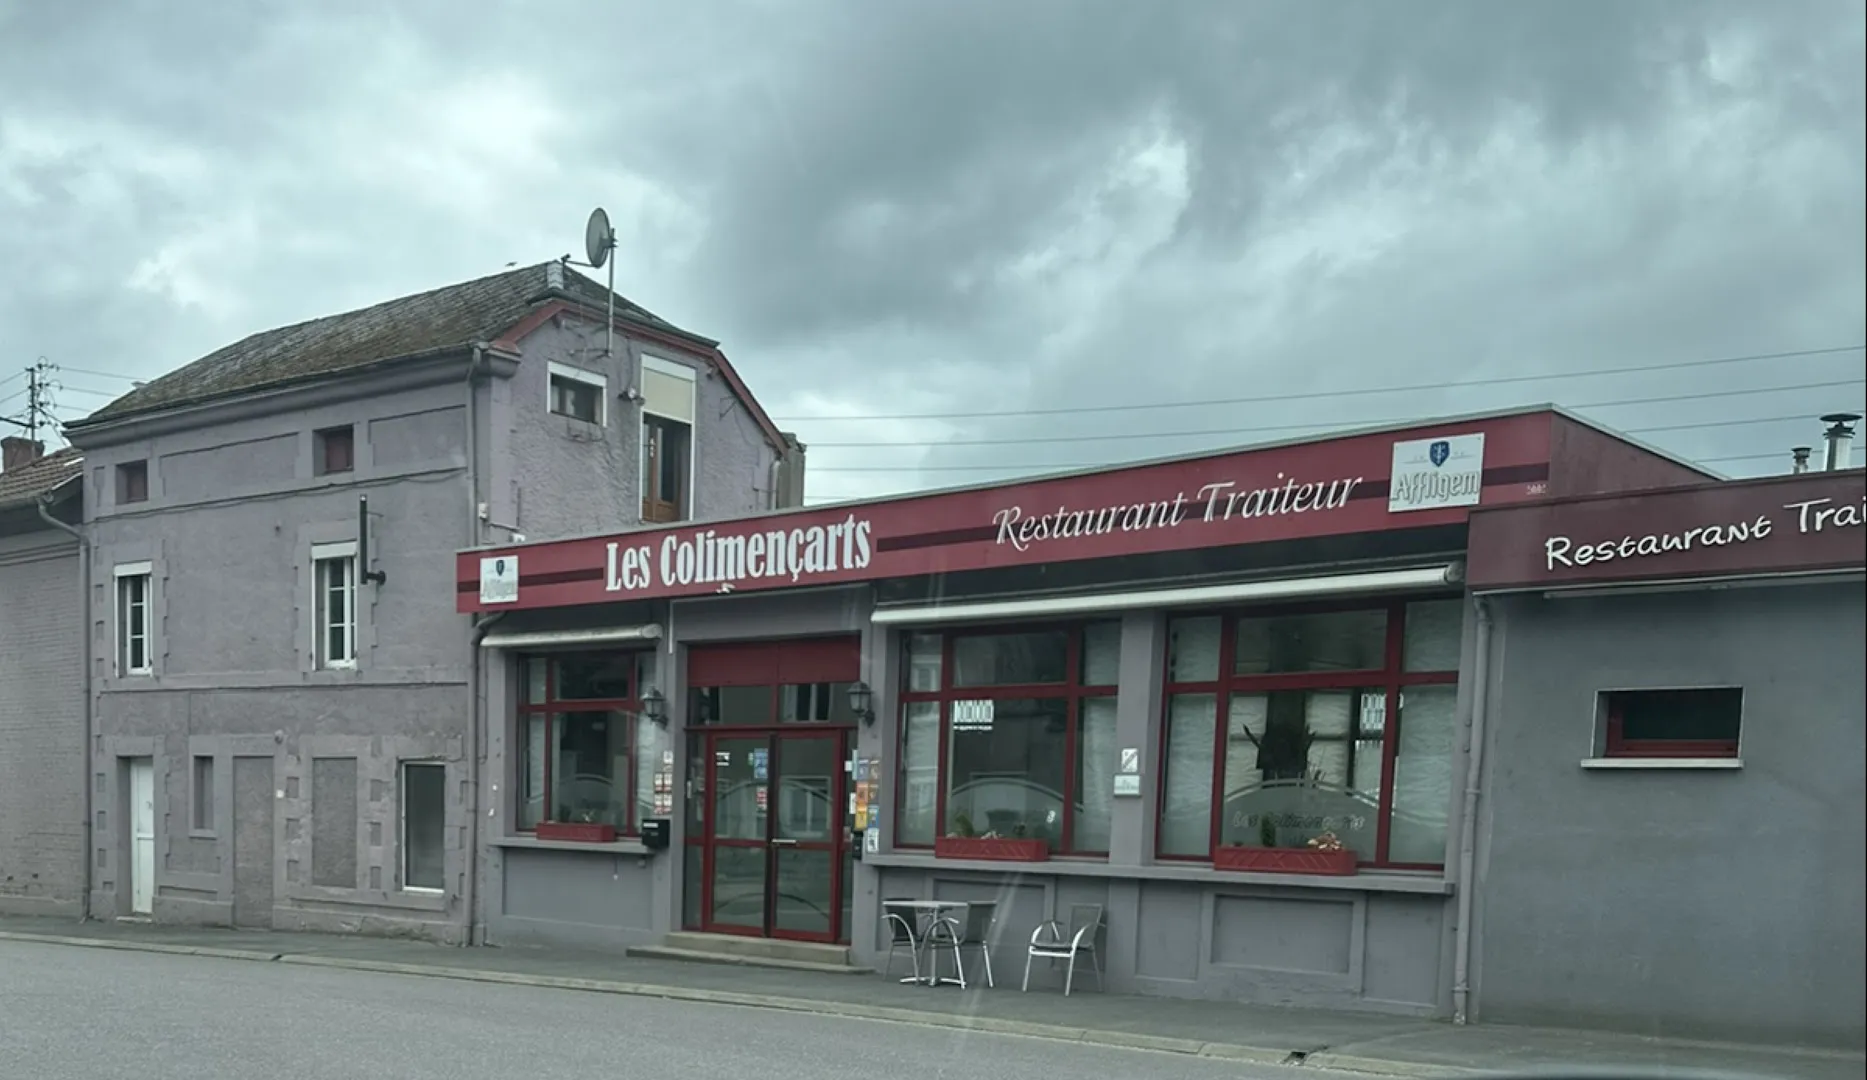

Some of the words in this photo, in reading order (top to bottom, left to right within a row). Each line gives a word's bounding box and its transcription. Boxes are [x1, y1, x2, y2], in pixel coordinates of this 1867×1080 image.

[992, 490, 1188, 552] Restaurant
[1197, 472, 1362, 522] Traiteur
[1391, 471, 1480, 505] Affligem
[605, 542, 651, 591] Les
[660, 513, 871, 586] Colimençarts
[1545, 515, 1772, 570] Restaurant
